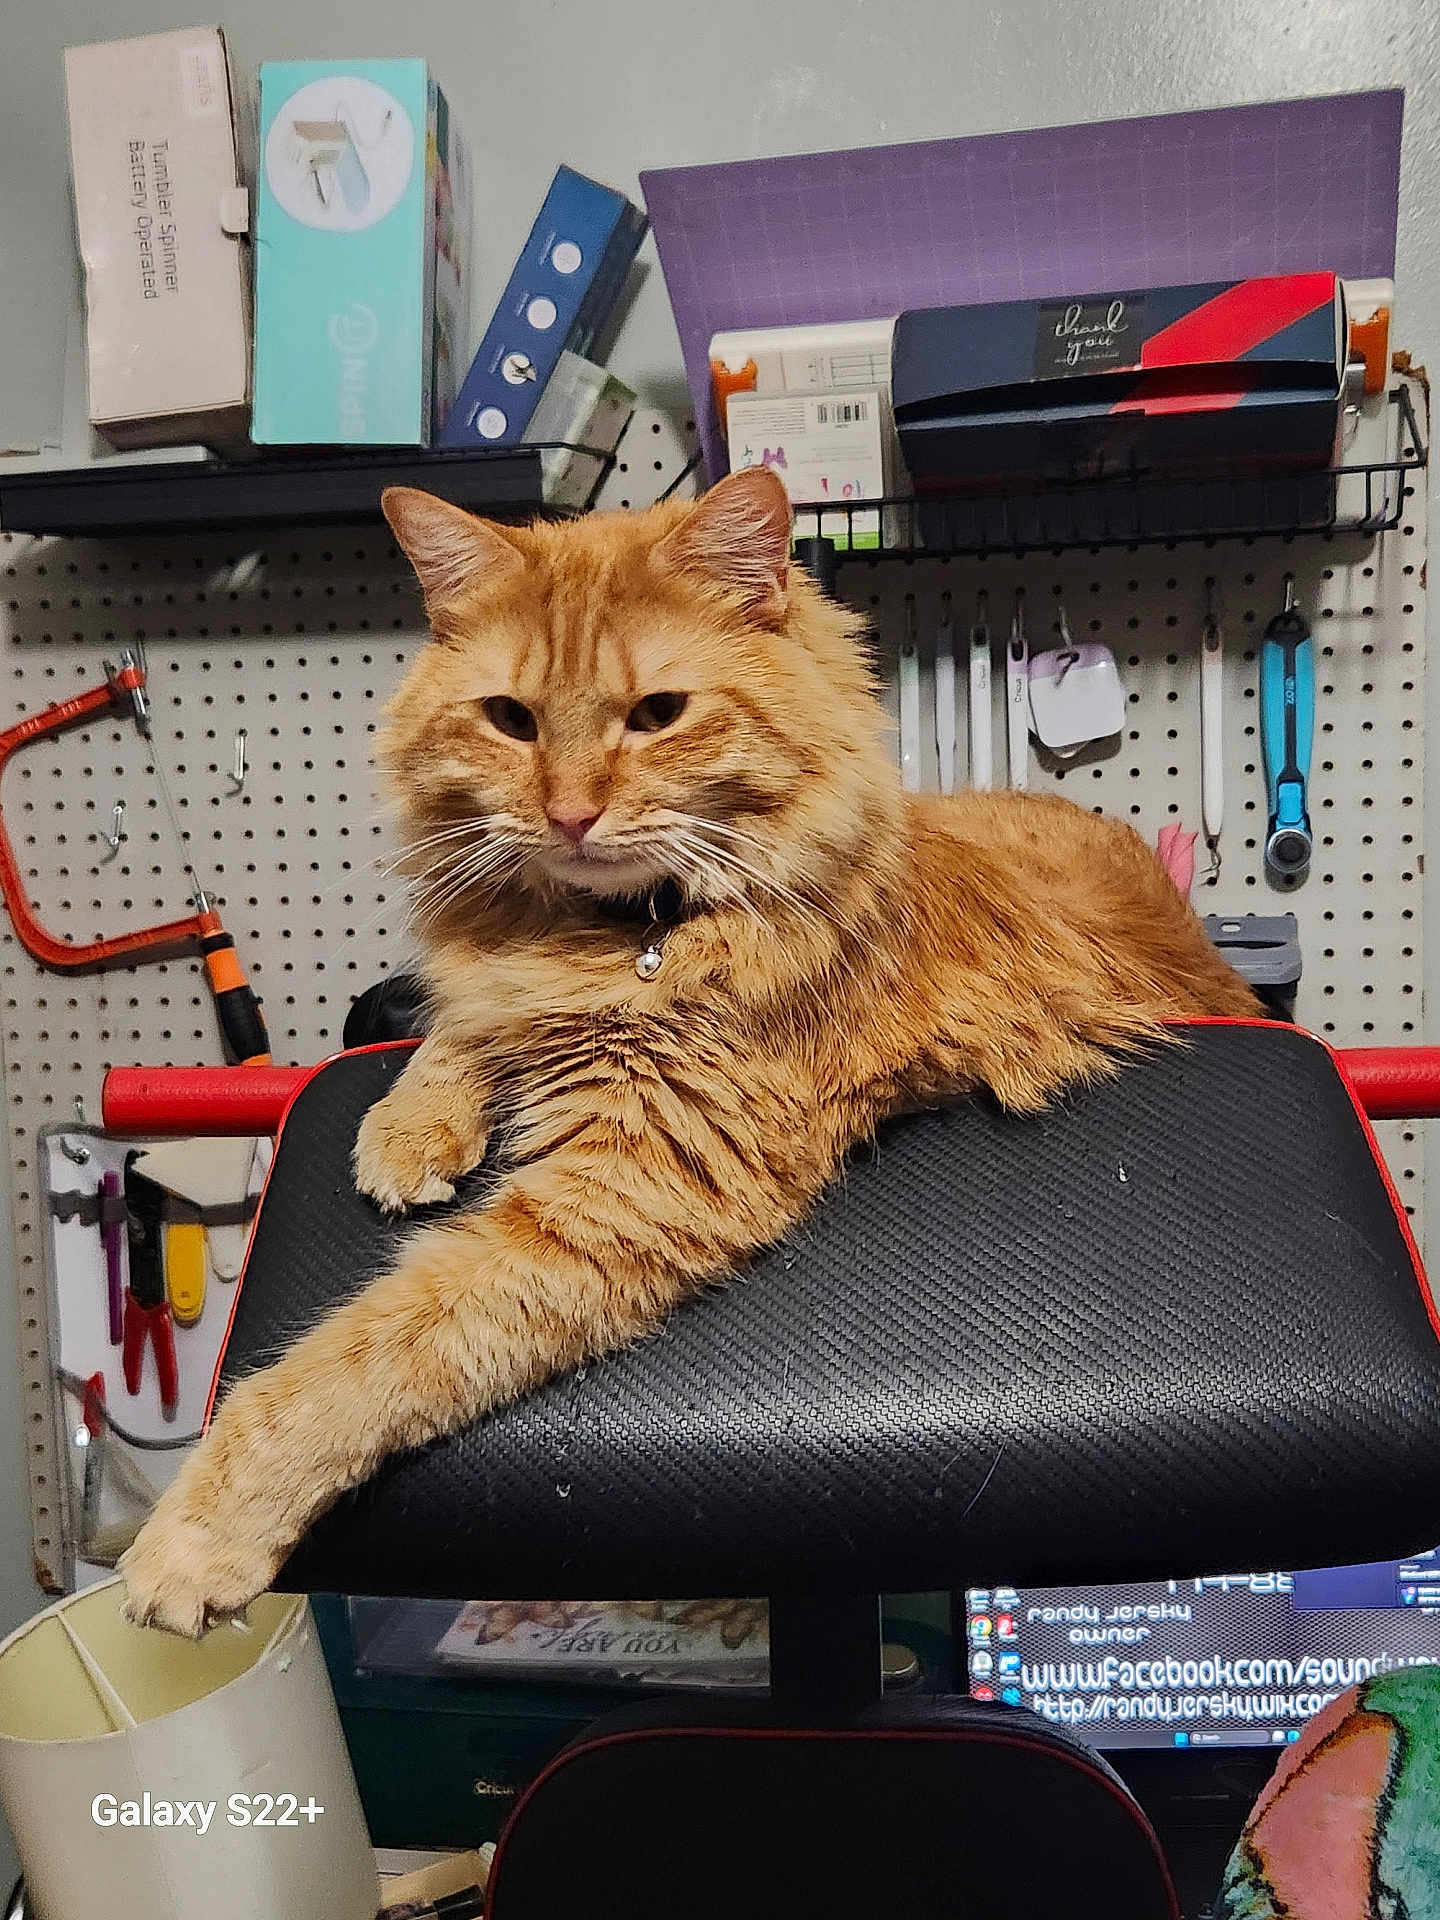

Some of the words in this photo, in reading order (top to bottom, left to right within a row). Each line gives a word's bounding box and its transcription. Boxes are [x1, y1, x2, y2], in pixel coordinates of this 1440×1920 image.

[128, 140, 148, 210] Battery
[151, 138, 172, 217] Tumbler
[135, 215, 159, 300] Operated
[158, 223, 179, 293] Spinner
[1069, 1626, 1152, 1646] owner
